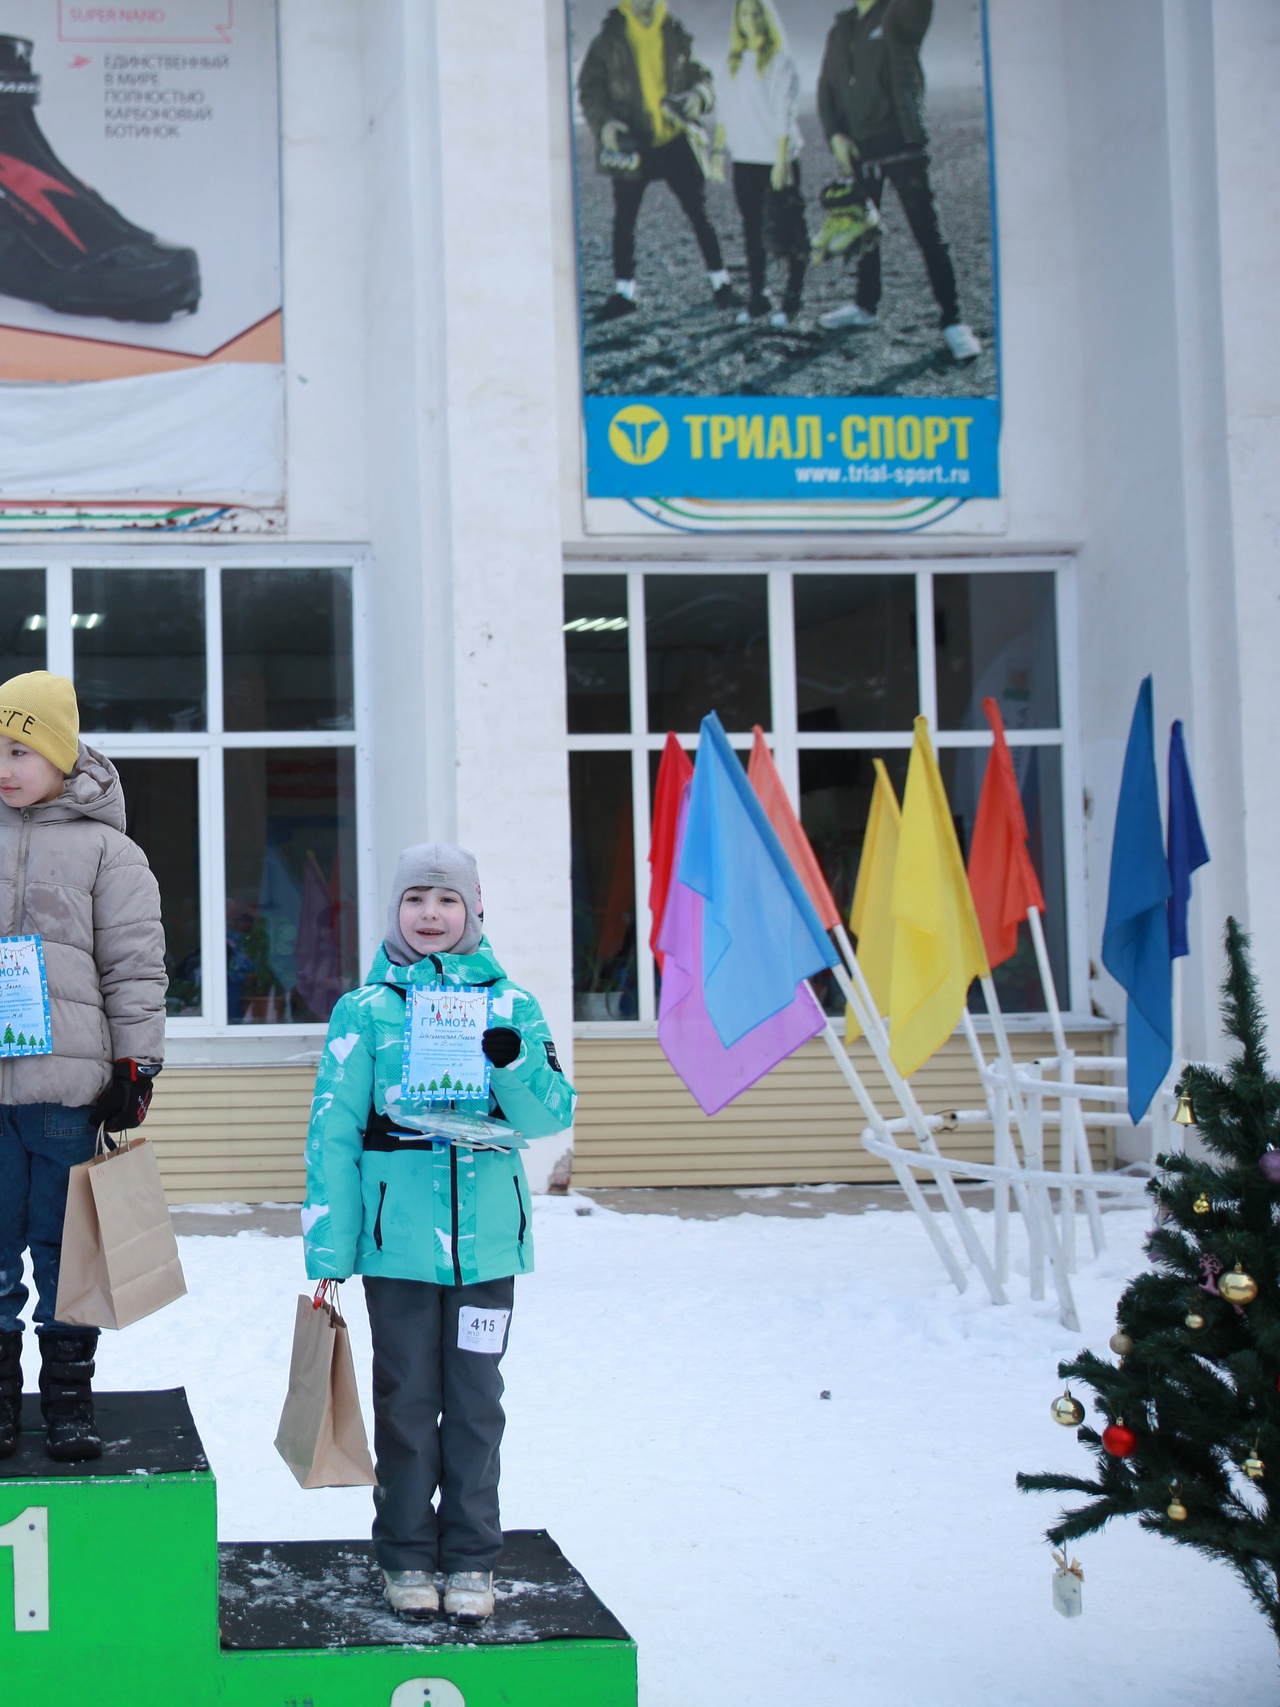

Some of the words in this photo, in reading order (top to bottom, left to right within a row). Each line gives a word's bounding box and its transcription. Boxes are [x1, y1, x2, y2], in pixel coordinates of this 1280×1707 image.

[70, 8, 116, 23] SUPER
[119, 8, 166, 23] NANO
[104, 55, 229, 70] ЕДИНСТВЕННЫЙ
[104, 73, 114, 87] В
[118, 73, 160, 87] МИРЕ
[104, 90, 205, 104] ПОЛНОСТЬЮ
[104, 107, 213, 121] КАРБОНОВЫЙ
[104, 125, 180, 139] БОТИНОК
[795, 463, 970, 486] www.trial-sport.ru
[421, 1017, 476, 1028] ГРАМОТА
[470, 1318, 495, 1332] 415
